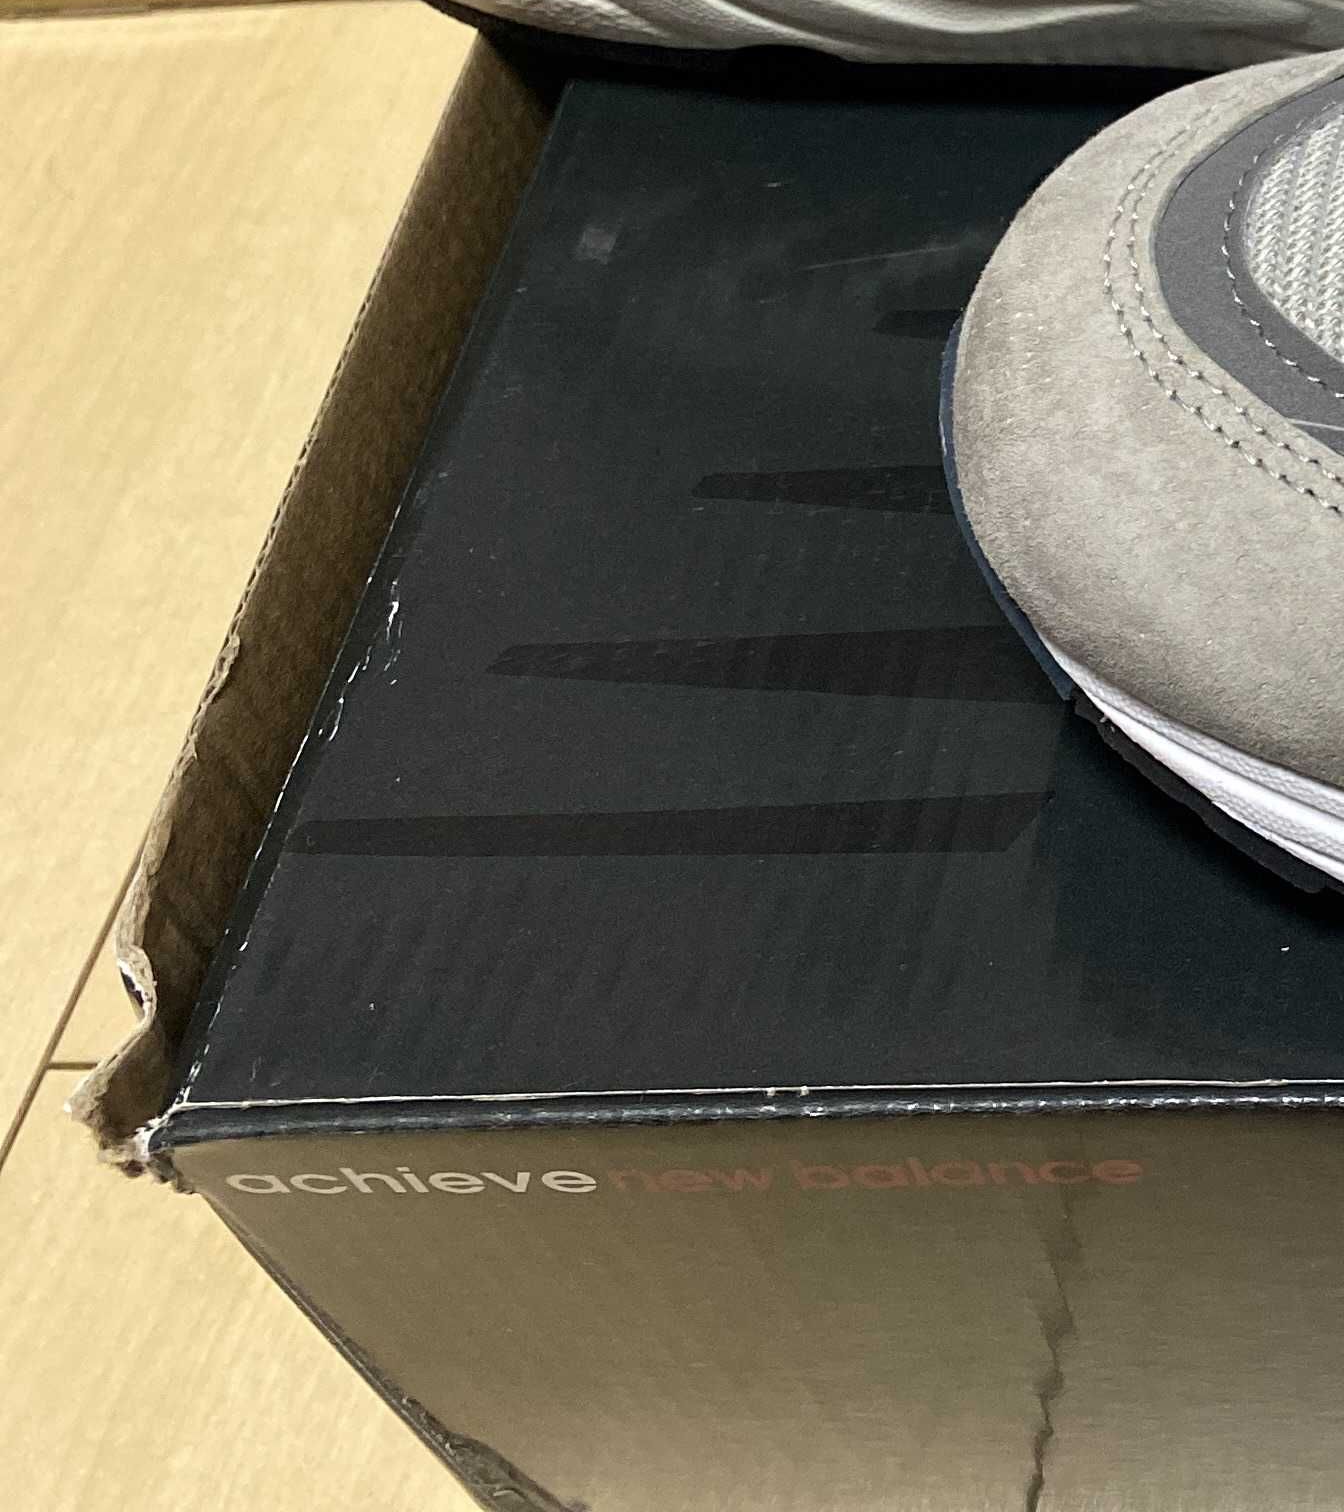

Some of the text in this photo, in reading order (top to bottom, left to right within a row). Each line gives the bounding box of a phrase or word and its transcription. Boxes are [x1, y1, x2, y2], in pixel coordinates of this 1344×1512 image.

[225, 1157, 1144, 1194] achieve new balance
